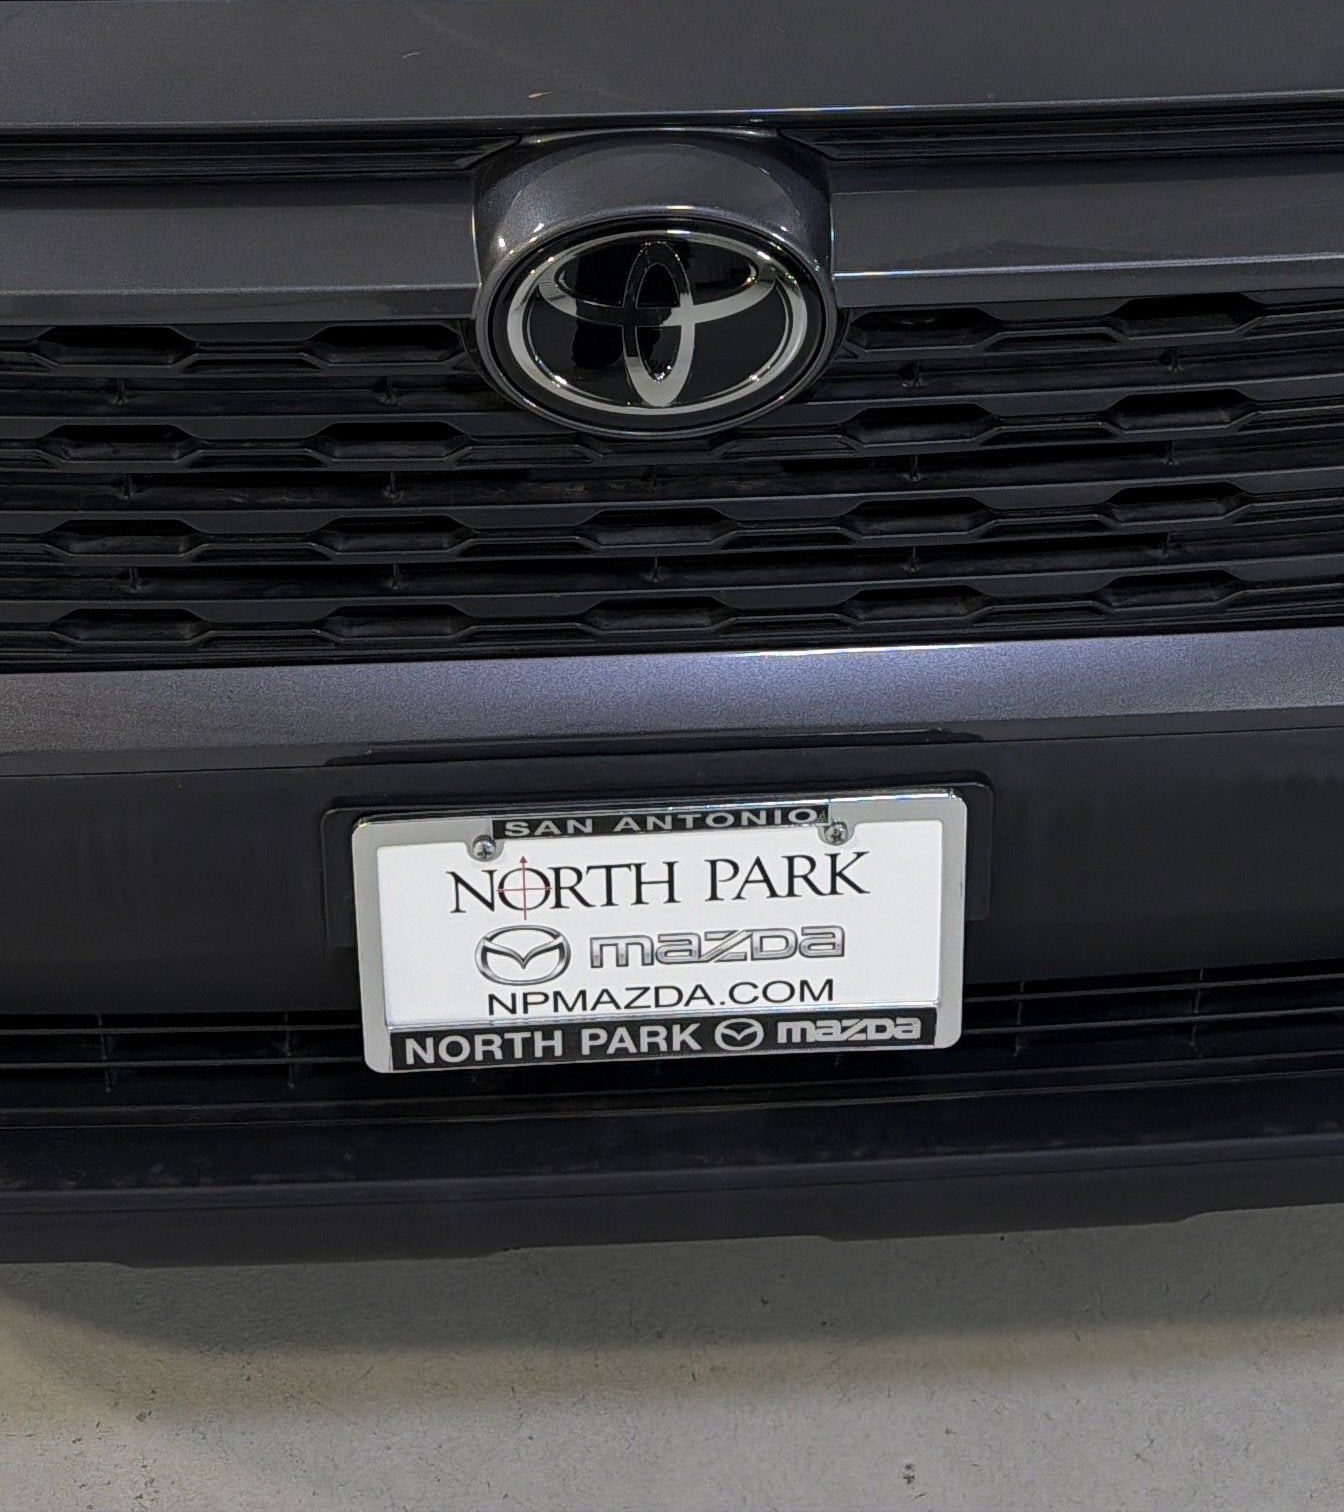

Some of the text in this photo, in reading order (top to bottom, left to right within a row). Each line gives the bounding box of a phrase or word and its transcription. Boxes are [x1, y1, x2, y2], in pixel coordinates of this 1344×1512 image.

[504, 808, 818, 837] SAN ANTONIO
[445, 851, 871, 914] NORTH PARK
[589, 925, 845, 969] mazda
[488, 978, 834, 1016] NPMAZDA.COM
[405, 1016, 922, 1065] NORTH PARK mazda
